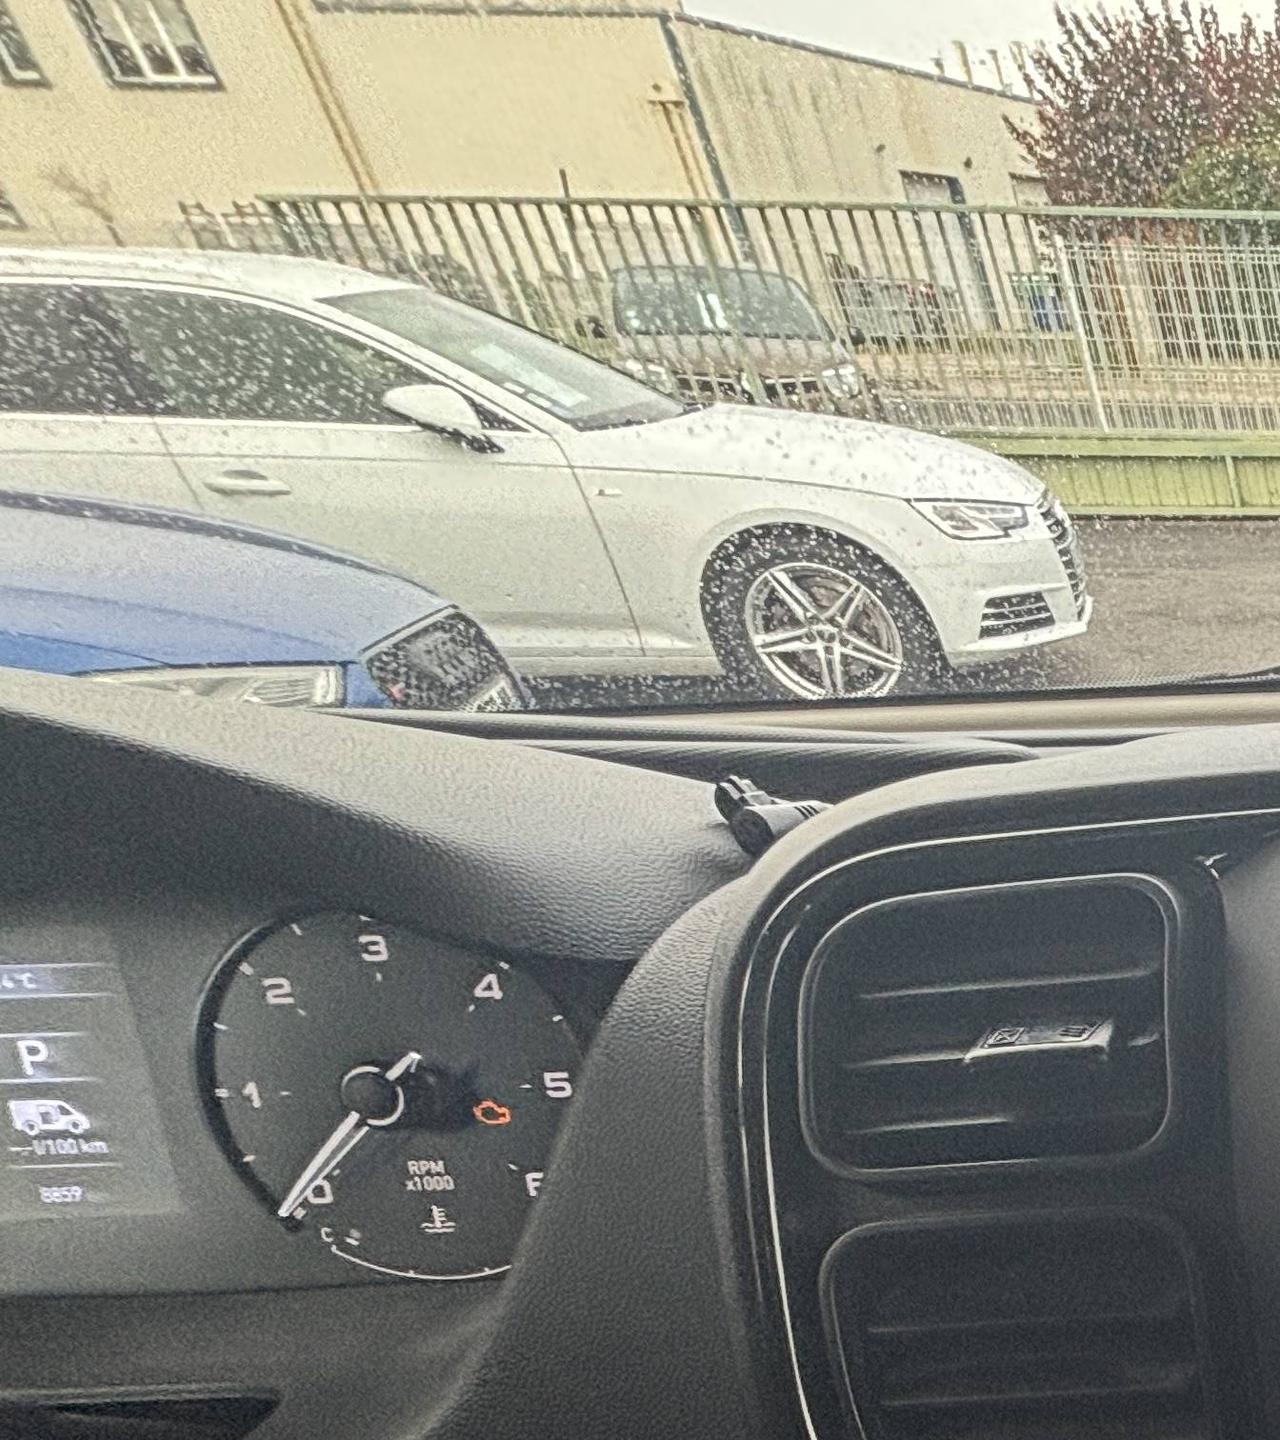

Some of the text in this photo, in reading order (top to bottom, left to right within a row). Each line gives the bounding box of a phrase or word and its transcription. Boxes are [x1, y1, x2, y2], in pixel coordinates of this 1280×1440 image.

[358, 935, 389, 962] 3
[261, 977, 295, 1005] 2
[473, 973, 504, 1001] 4
[17, 1039, 49, 1076] P
[241, 1082, 262, 1109] 1
[543, 1071, 574, 1099] 5
[407, 1160, 446, 1175] RPM
[404, 1175, 456, 1191] x1000
